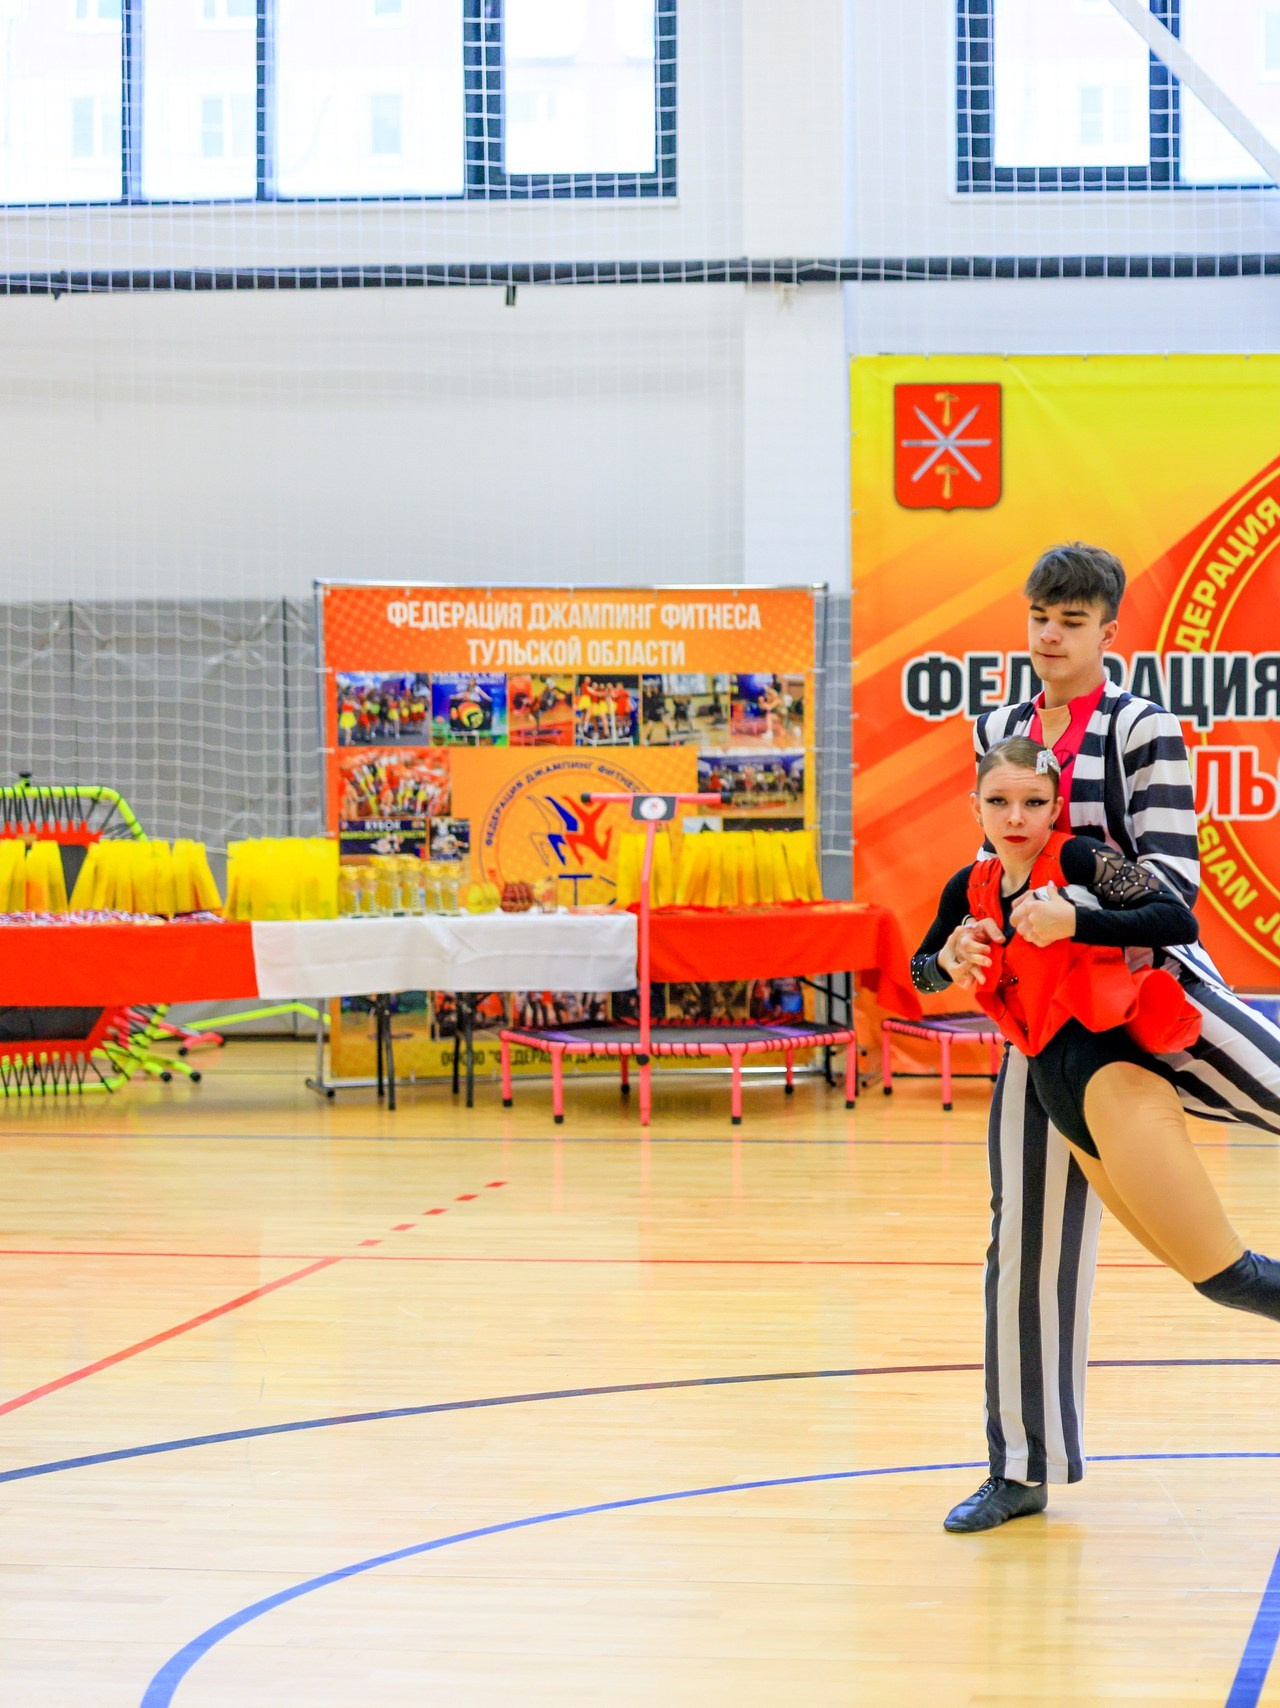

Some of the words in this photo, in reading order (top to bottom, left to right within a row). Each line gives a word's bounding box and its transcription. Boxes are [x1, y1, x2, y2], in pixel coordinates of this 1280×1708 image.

[387, 600, 523, 633] ФЕДЕРАЦИЯ
[527, 602, 656, 633] ДЖАМПИНГ
[660, 602, 761, 630] ФИТНЕСА
[467, 636, 583, 667] ТУЛЬСКОЙ
[587, 638, 686, 667] ОБЛАСТИ
[1198, 822, 1259, 911] SIAN
